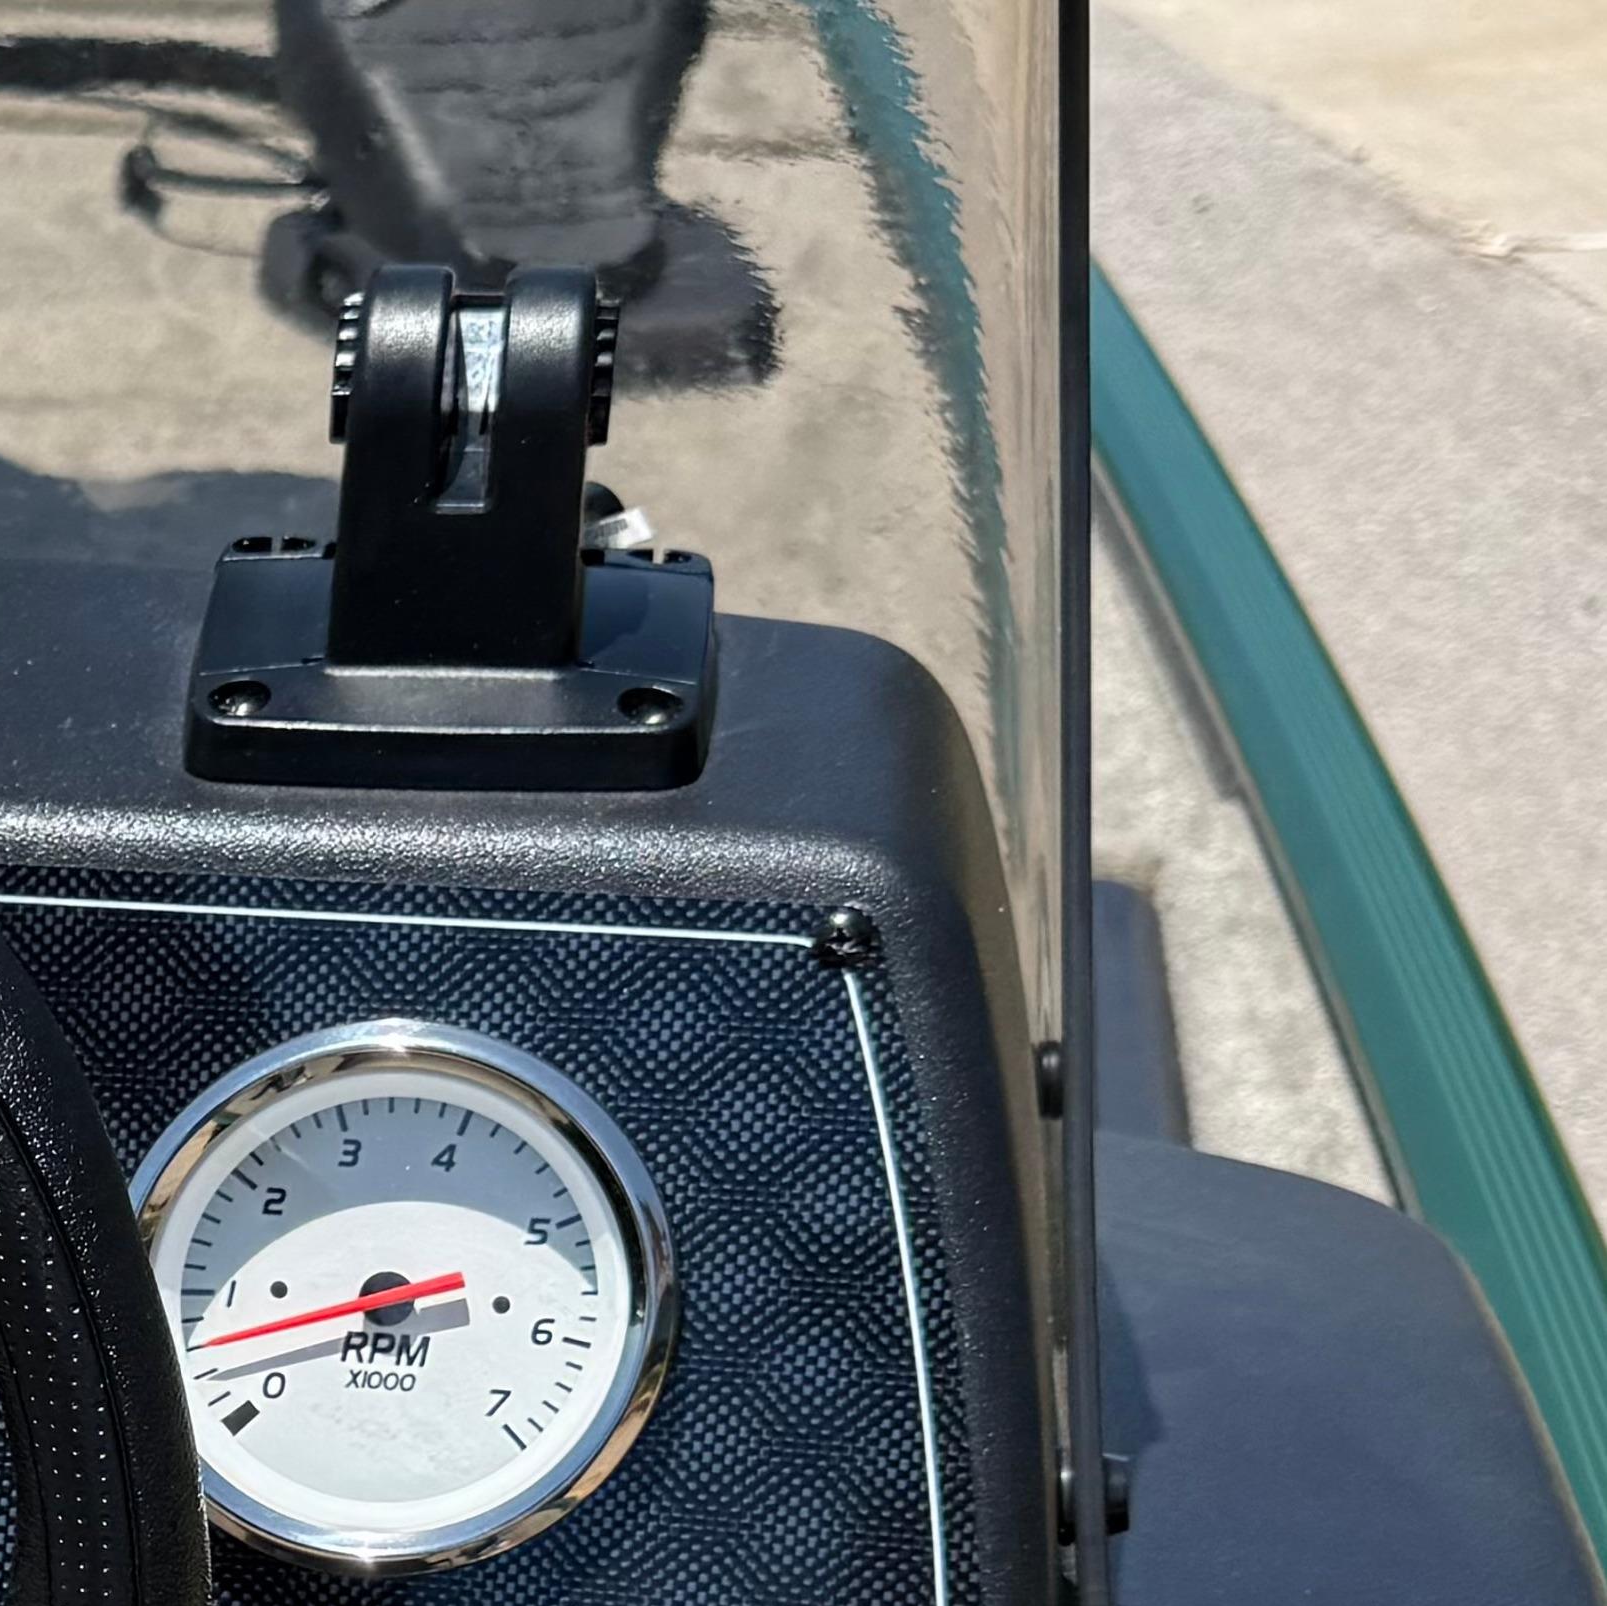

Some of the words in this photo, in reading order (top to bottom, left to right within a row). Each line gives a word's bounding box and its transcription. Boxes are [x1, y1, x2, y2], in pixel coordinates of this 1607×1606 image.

[337, 1138, 362, 1168] 3
[430, 1143, 458, 1173] 4
[261, 1186, 288, 1217] 2
[523, 1217, 552, 1246] 5
[226, 1279, 237, 1308] 1
[530, 1317, 554, 1346] 6
[340, 1331, 432, 1368] RPM
[262, 1371, 287, 1400] 0
[345, 1369, 417, 1393] X1000
[484, 1388, 512, 1417] 7
